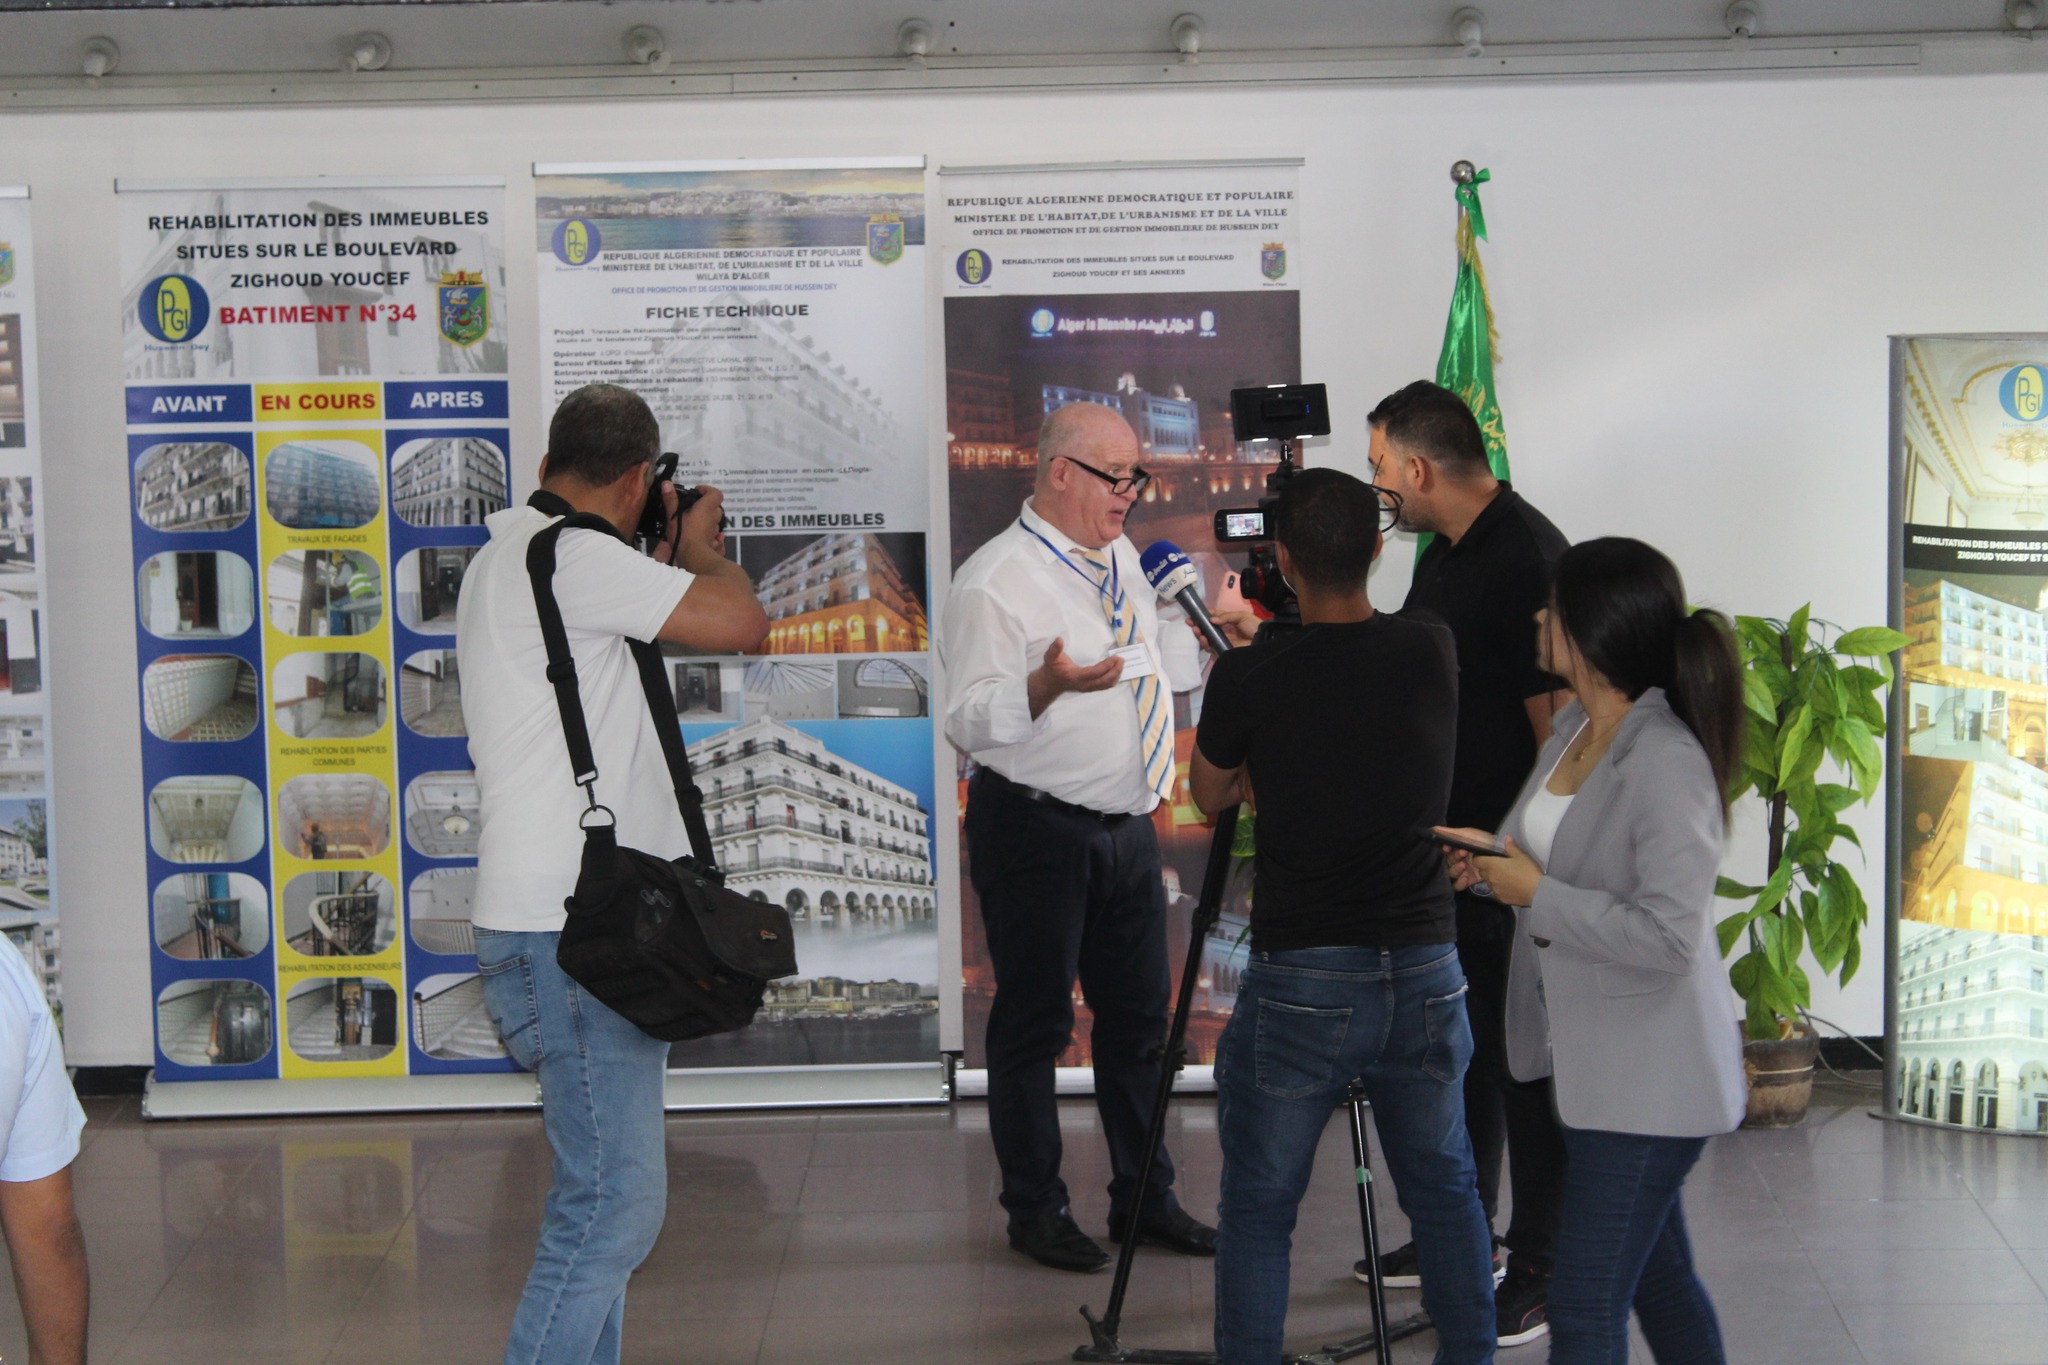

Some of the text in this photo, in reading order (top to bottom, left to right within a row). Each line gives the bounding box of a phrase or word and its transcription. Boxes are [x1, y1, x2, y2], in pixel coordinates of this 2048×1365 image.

[947, 191, 1294, 208] REPUBLIQUE ALGERIENNE DEMOCRATIQUE ET POPULAIRE
[149, 211, 489, 230] REHABILITATION DES IMMEUBLES
[954, 214, 1017, 223] MINISTERE
[1020, 213, 1034, 222] DE
[1120, 210, 1198, 220] L'URBANISME
[1200, 210, 1214, 218] ET
[1218, 210, 1234, 218] DE
[1236, 209, 1251, 217] LA
[1254, 208, 1288, 217] VILLE
[972, 228, 1004, 236] OFFICE
[1006, 228, 1018, 236] DE
[1020, 226, 1074, 235] PROMOTION
[1075, 226, 1086, 234] ET
[1088, 226, 1101, 234] DE
[1144, 224, 1204, 232] IMMOBILIERE
[1220, 223, 1260, 231] HUSSEIN
[1261, 222, 1280, 230] DEY
[176, 241, 458, 260] SITUES SUR LE BOULEVARD
[603, 248, 862, 260] REPUBLIQUE ALGERIENNE DEMOCRATIQUE ET POPULAIRE
[602, 263, 652, 272] MINISTERE
[732, 260, 793, 268] L'URBANISME
[795, 260, 806, 268] ET
[809, 260, 821, 268] DE
[837, 259, 864, 267] VILLE
[1002, 258, 1064, 266] REHABILITATION
[1083, 256, 1128, 264] IMMEUBLES
[1188, 254, 1234, 262] BOULEVARD
[230, 272, 411, 288] ZIGHOUD YOUCEF
[732, 272, 770, 280] D'ALGER
[1090, 270, 1118, 278] YOUCEF
[1150, 268, 1186, 276] ANNEXES
[636, 286, 646, 294] DE
[647, 286, 688, 294] PROMOTION
[708, 284, 738, 292] GESTION
[739, 284, 783, 292] IMMOBILIERE
[219, 304, 417, 326] BATIMENT N°34
[646, 304, 810, 318] FICHE TECHNIQUE
[1057, 318, 1085, 333] Alger
[1097, 318, 1138, 332] Blanche
[190, 344, 209, 353] Dey
[151, 394, 227, 414] AVANT
[261, 392, 376, 411] EN COURS
[410, 391, 484, 408] APRES
[742, 516, 776, 528] DES
[782, 513, 885, 527] IMMEUBLES
[288, 535, 320, 543] TRAVAUX
[322, 535, 331, 543] DE
[1912, 536, 1972, 548] REHABILITATION
[1972, 540, 1989, 549] DES
[1990, 540, 2042, 550] IMMEUBLES
[1957, 550, 1994, 560] ZIGHOUD
[1995, 552, 2030, 562] YOUCEF
[2030, 553, 2042, 562] ET
[1158, 578, 1177, 593] News
[280, 745, 387, 756] REHABILITATION DES PARTIES
[312, 758, 356, 766] COMMUNES
[278, 962, 402, 973] REHABILITATION DES ASCENSEURS
